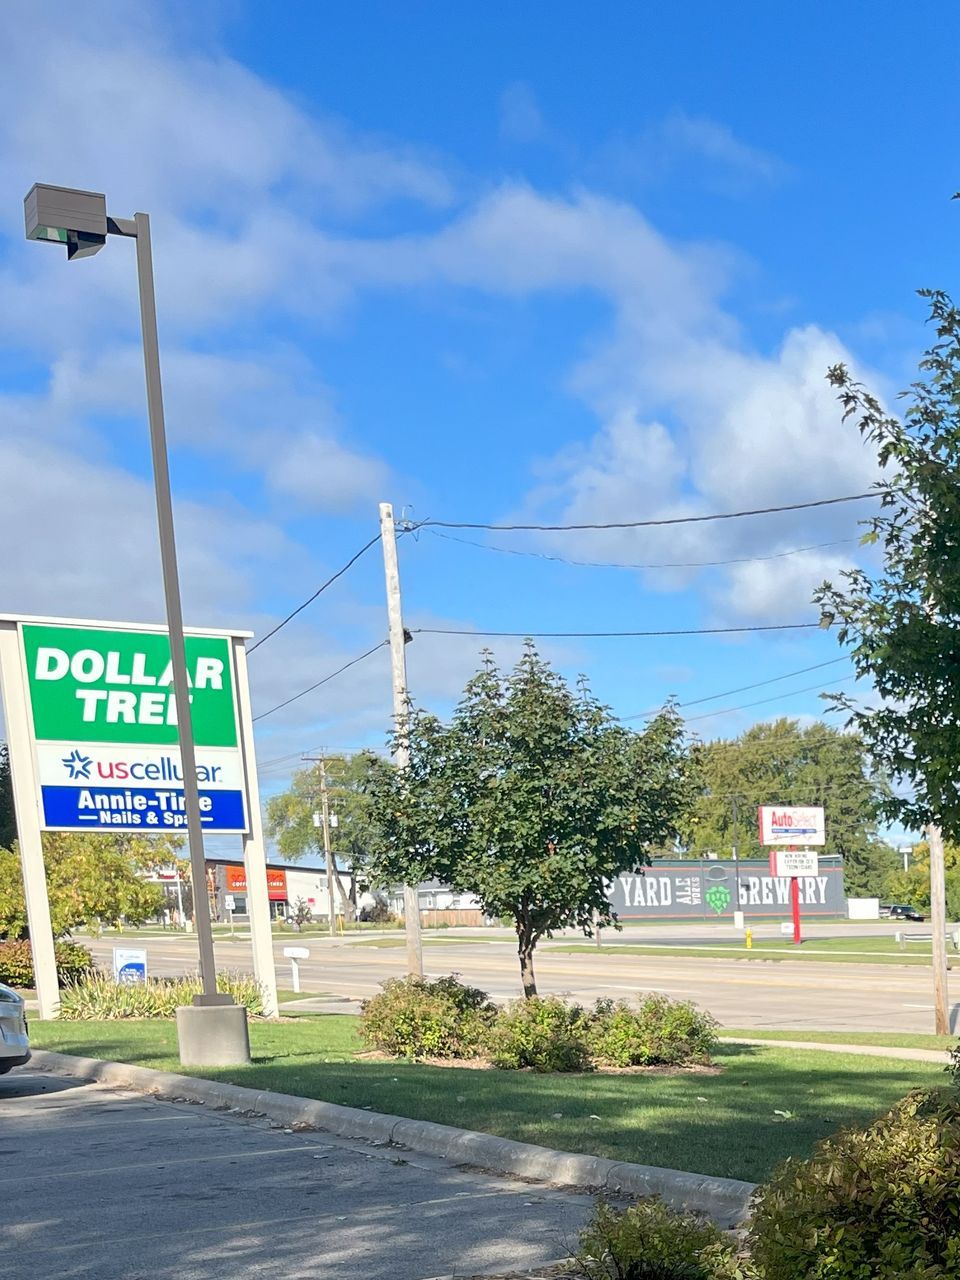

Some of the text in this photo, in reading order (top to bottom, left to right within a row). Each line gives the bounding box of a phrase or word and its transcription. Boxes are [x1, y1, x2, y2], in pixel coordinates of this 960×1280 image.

[97, 756, 222, 783] uscelluar
[100, 811, 141, 825] Nails
[146, 811, 158, 825] &
[619, 877, 672, 907] YARD
[676, 877, 691, 905] ALE
[735, 876, 829, 905] REWRY
